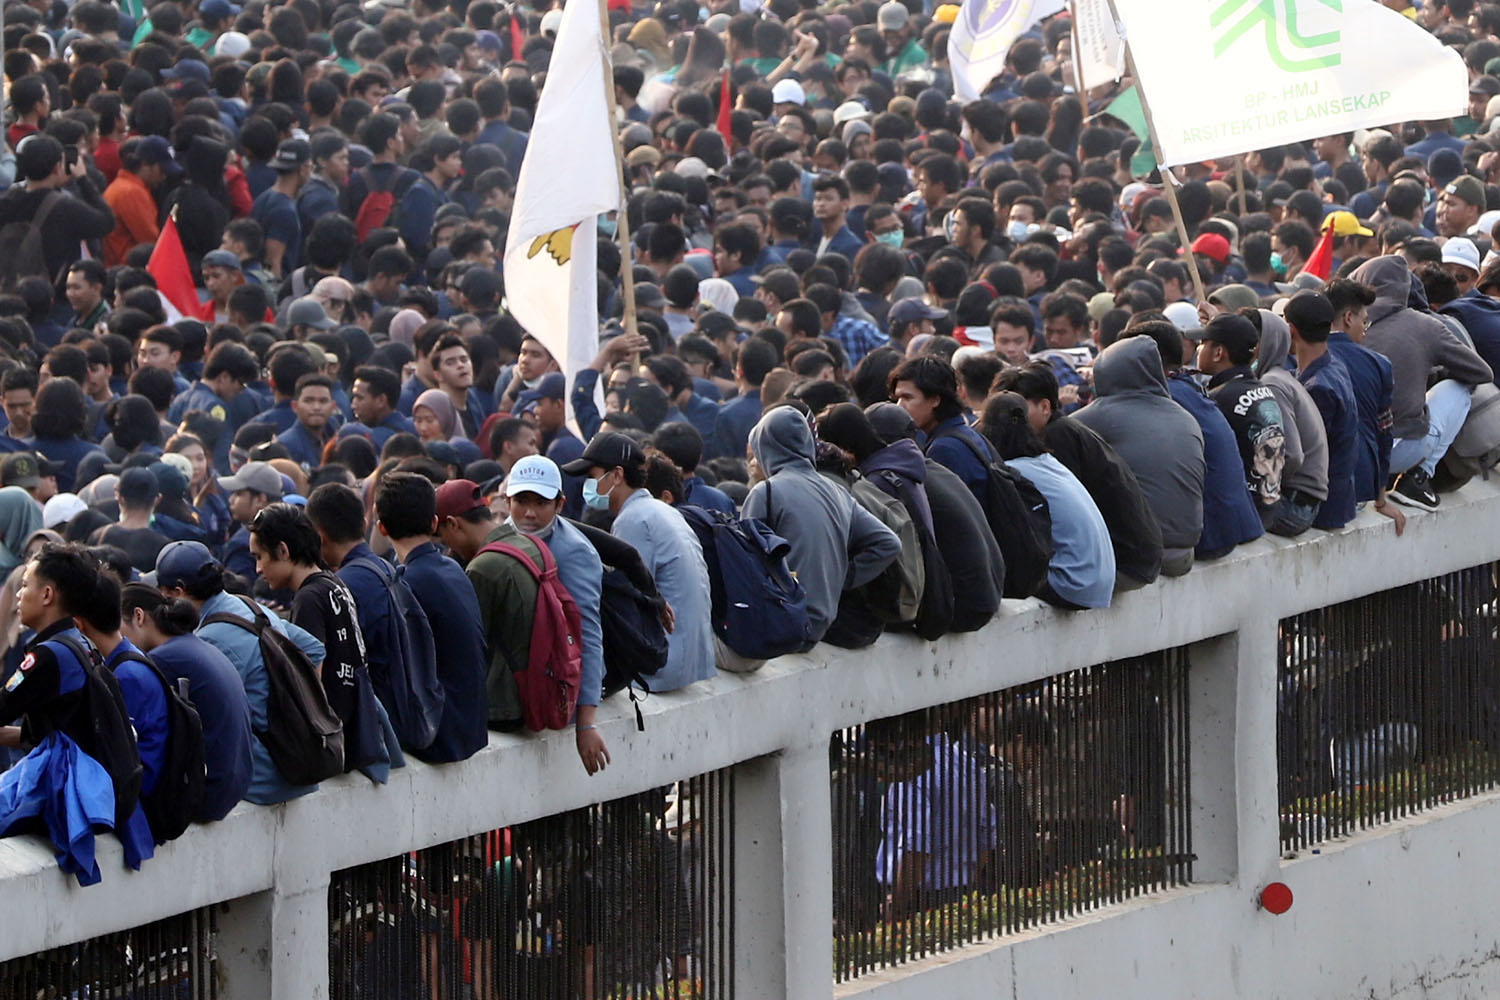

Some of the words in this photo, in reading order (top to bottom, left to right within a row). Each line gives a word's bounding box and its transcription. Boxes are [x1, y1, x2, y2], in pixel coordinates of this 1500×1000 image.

[1244, 92, 1267, 109] BP
[1282, 79, 1319, 100] HMJ
[1183, 109, 1289, 144] ARSITEKTUR
[1294, 90, 1392, 122] LANSEKAP
[336, 627, 347, 642] 19
